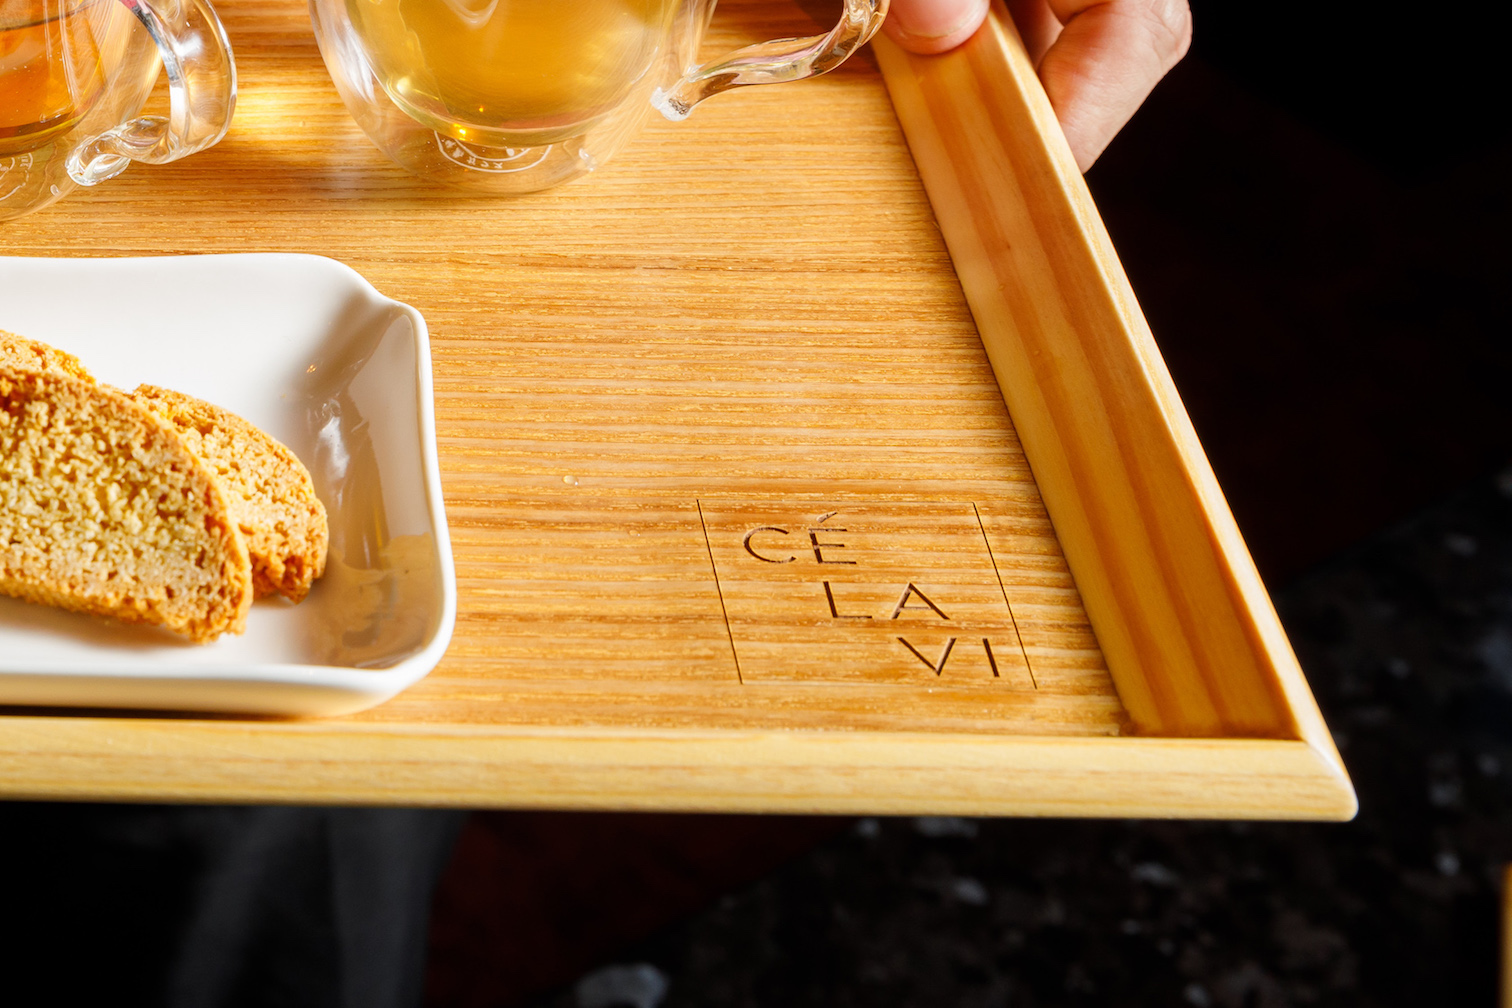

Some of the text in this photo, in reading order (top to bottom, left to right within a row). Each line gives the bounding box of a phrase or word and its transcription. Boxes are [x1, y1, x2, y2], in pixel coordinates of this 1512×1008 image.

[743, 511, 858, 565] CÉ
[822, 580, 950, 620] LA
[897, 637, 1000, 677] VI
